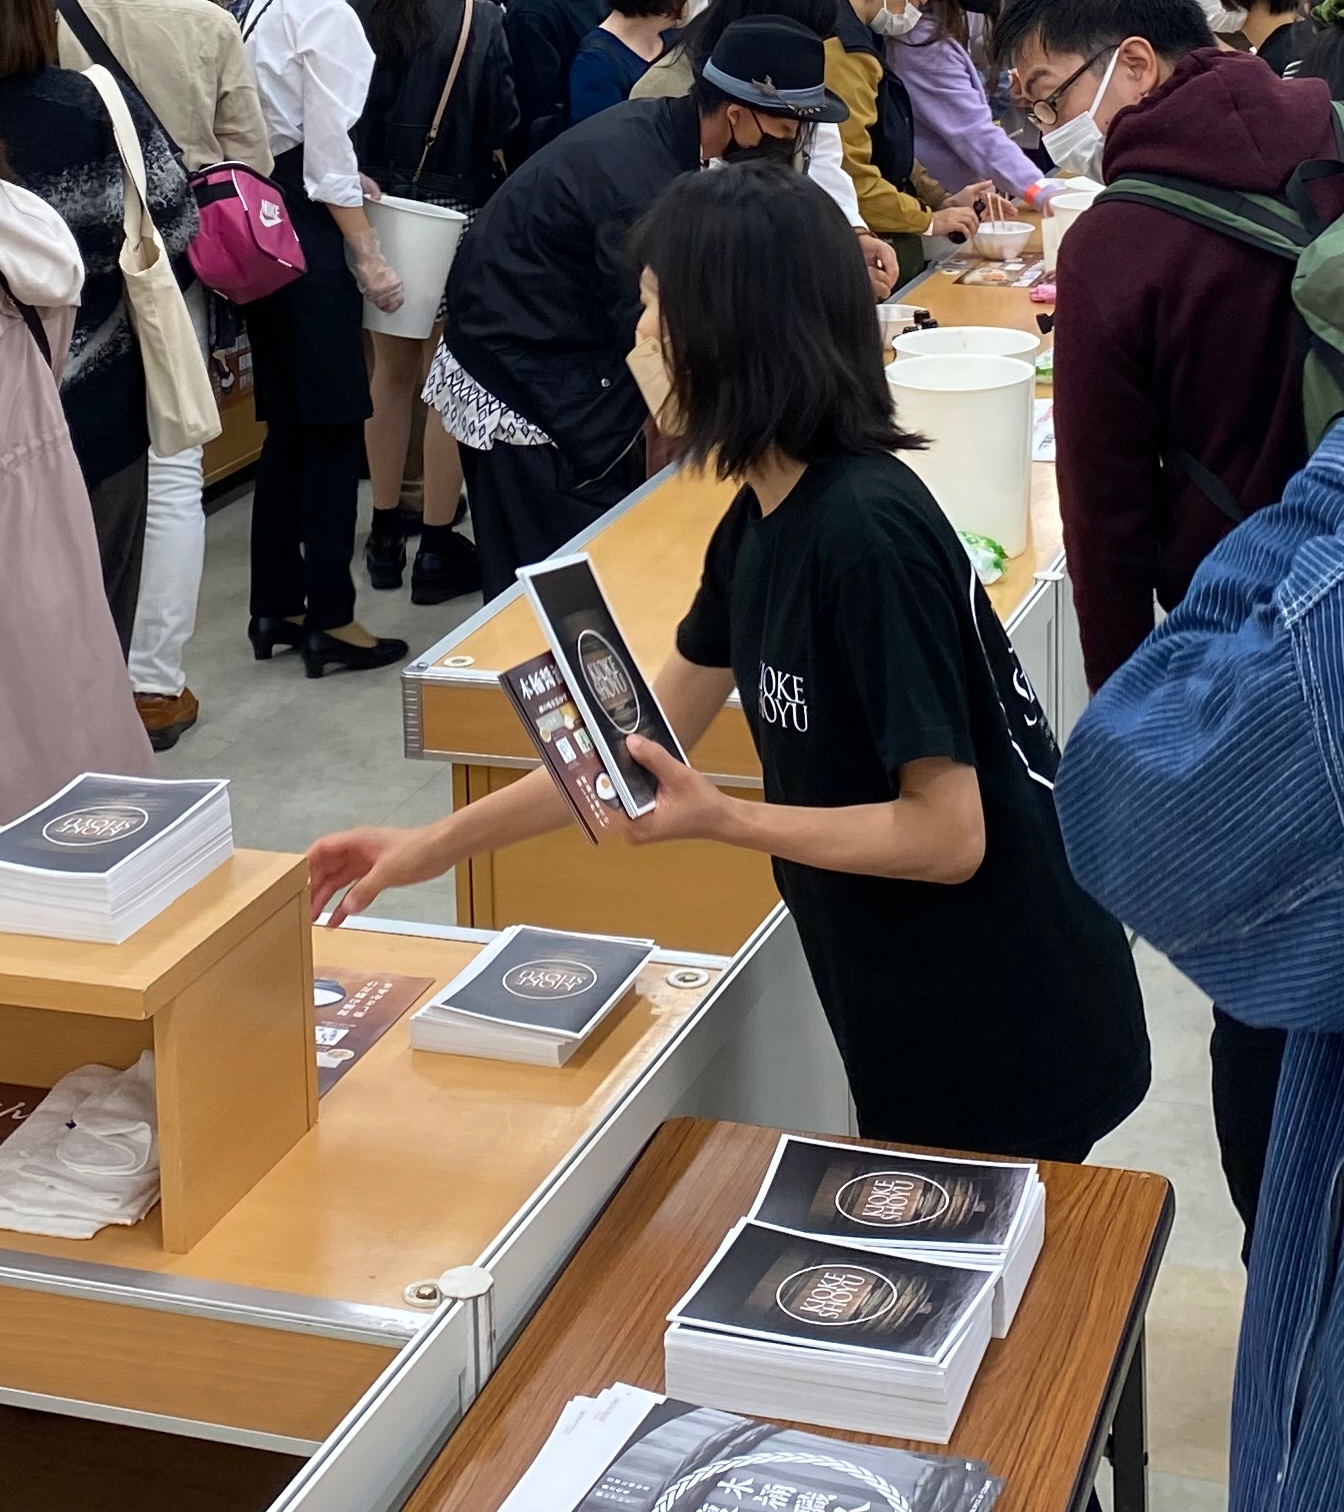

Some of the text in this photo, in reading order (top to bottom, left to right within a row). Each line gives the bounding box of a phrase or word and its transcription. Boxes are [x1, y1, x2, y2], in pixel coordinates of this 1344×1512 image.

[861, 1179, 896, 1218] KIOKE
[881, 1179, 916, 1222] SHOYU
[799, 1272, 846, 1314] KIOKE
[819, 1273, 866, 1321] SHOYU
